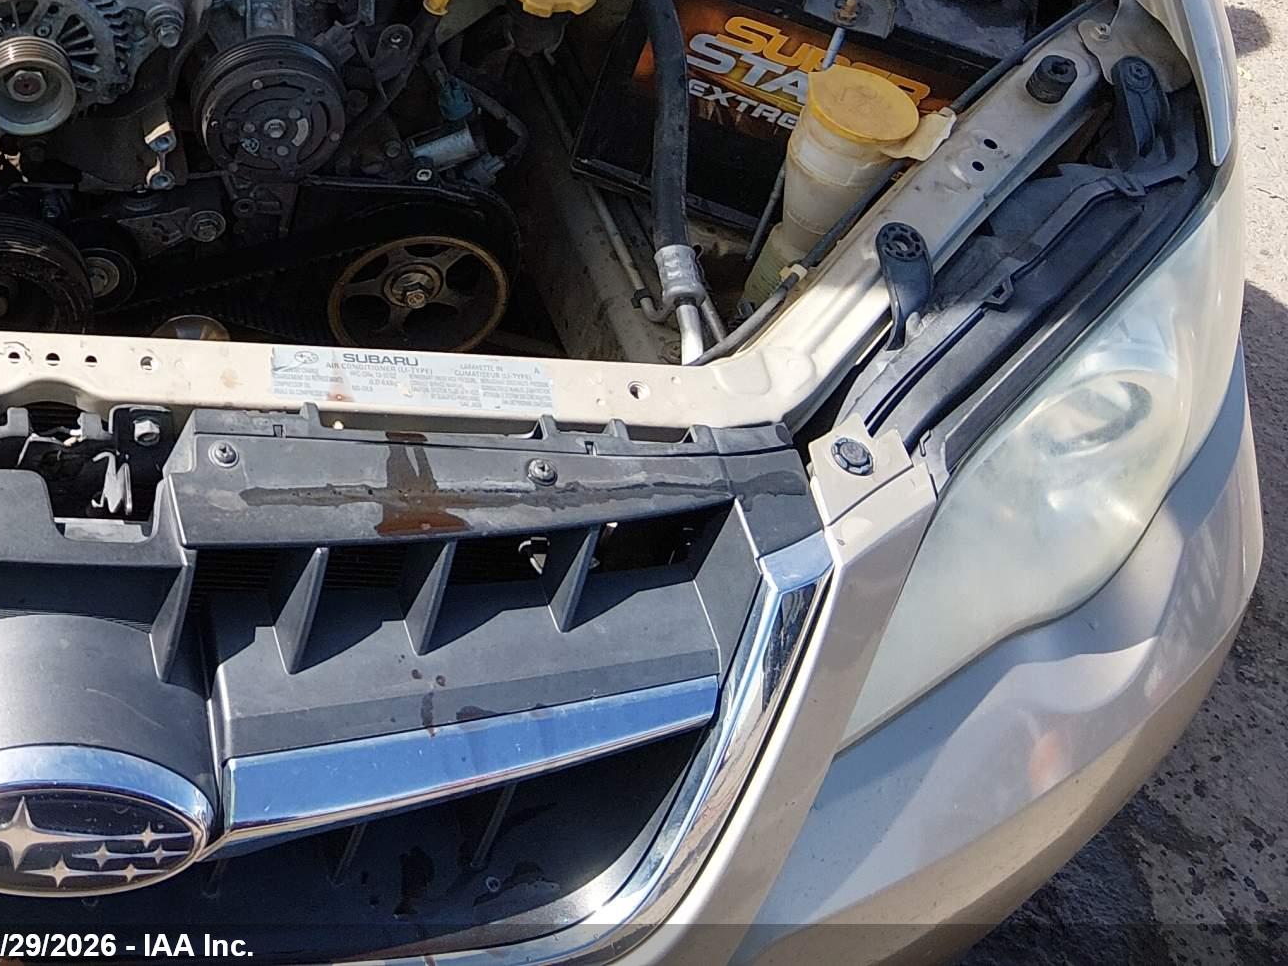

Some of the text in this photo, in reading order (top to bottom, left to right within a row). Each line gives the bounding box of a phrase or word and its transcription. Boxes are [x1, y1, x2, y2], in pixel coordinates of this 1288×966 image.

[343, 352, 419, 366] SUBARU
[326, 362, 340, 370] AIR
[341, 362, 396, 373] CONDITIONER
